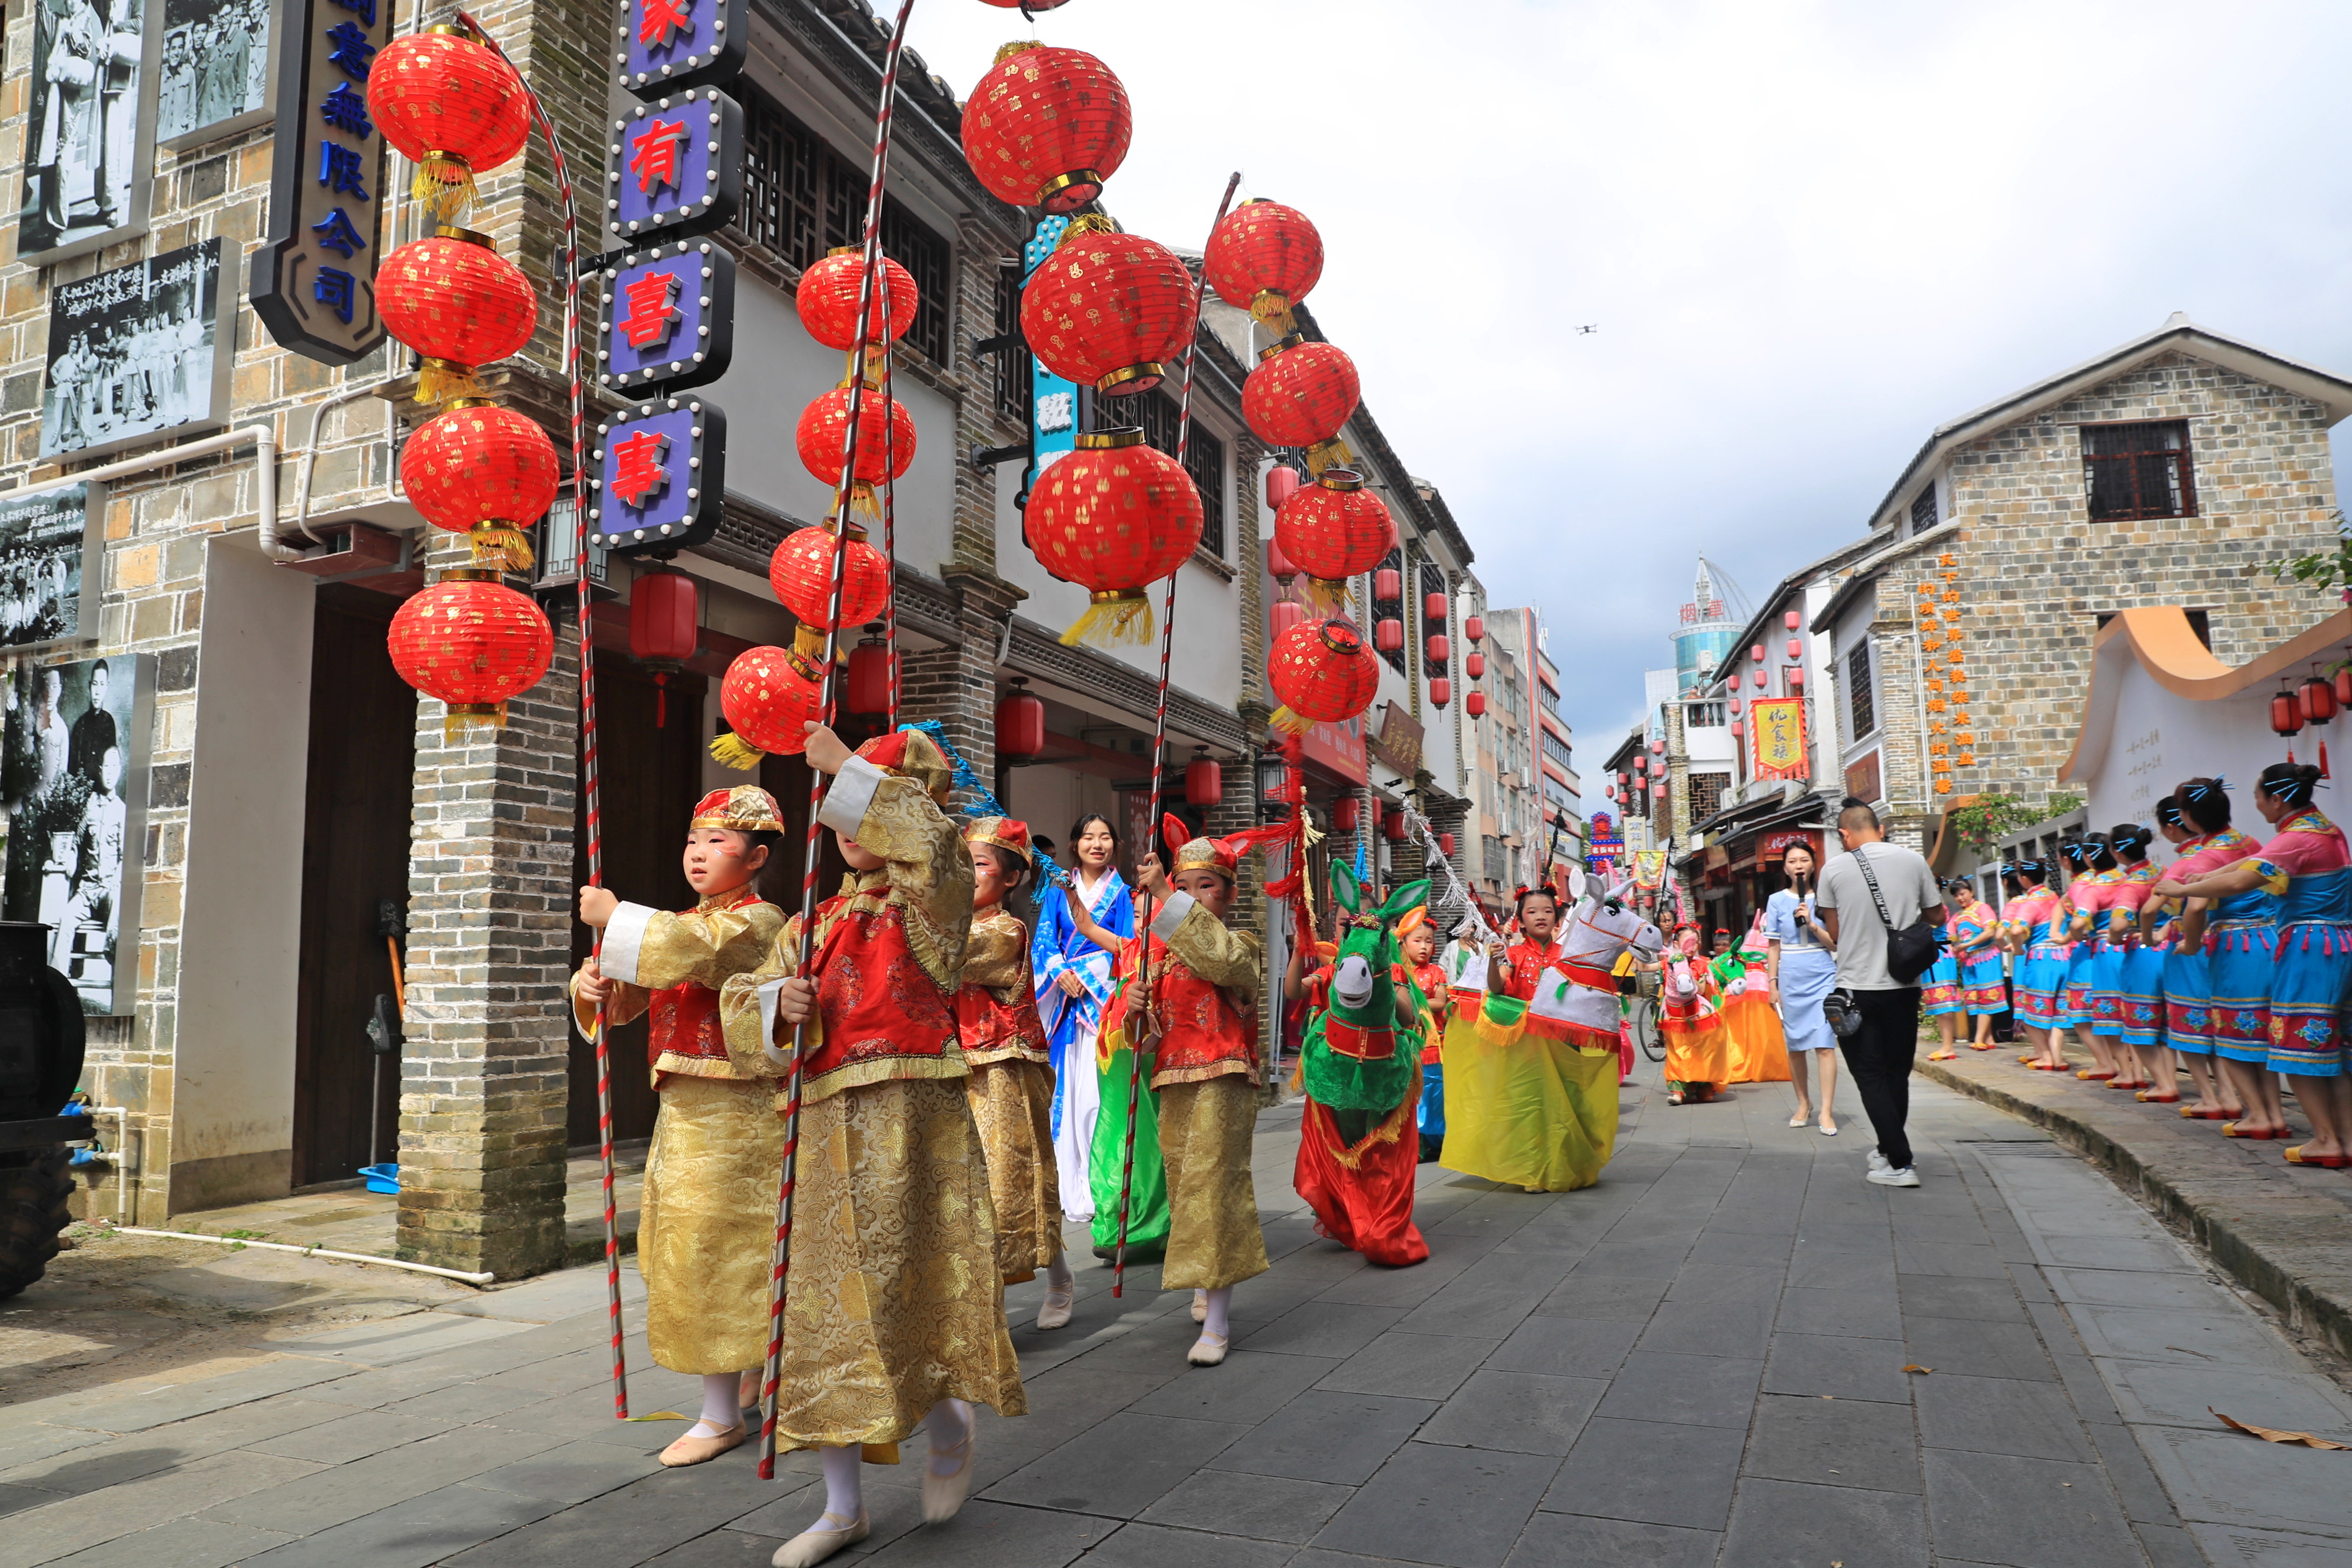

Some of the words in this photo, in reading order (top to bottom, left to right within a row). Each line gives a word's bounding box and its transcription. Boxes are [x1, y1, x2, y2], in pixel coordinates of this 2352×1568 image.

[1680, 599, 1724, 623] 烟草
[1939, 553, 1976, 765] 瓦下的世界盛装柴米油盐
[1858, 859, 1877, 884] HORSE
[1870, 885, 1885, 905] WOLF
